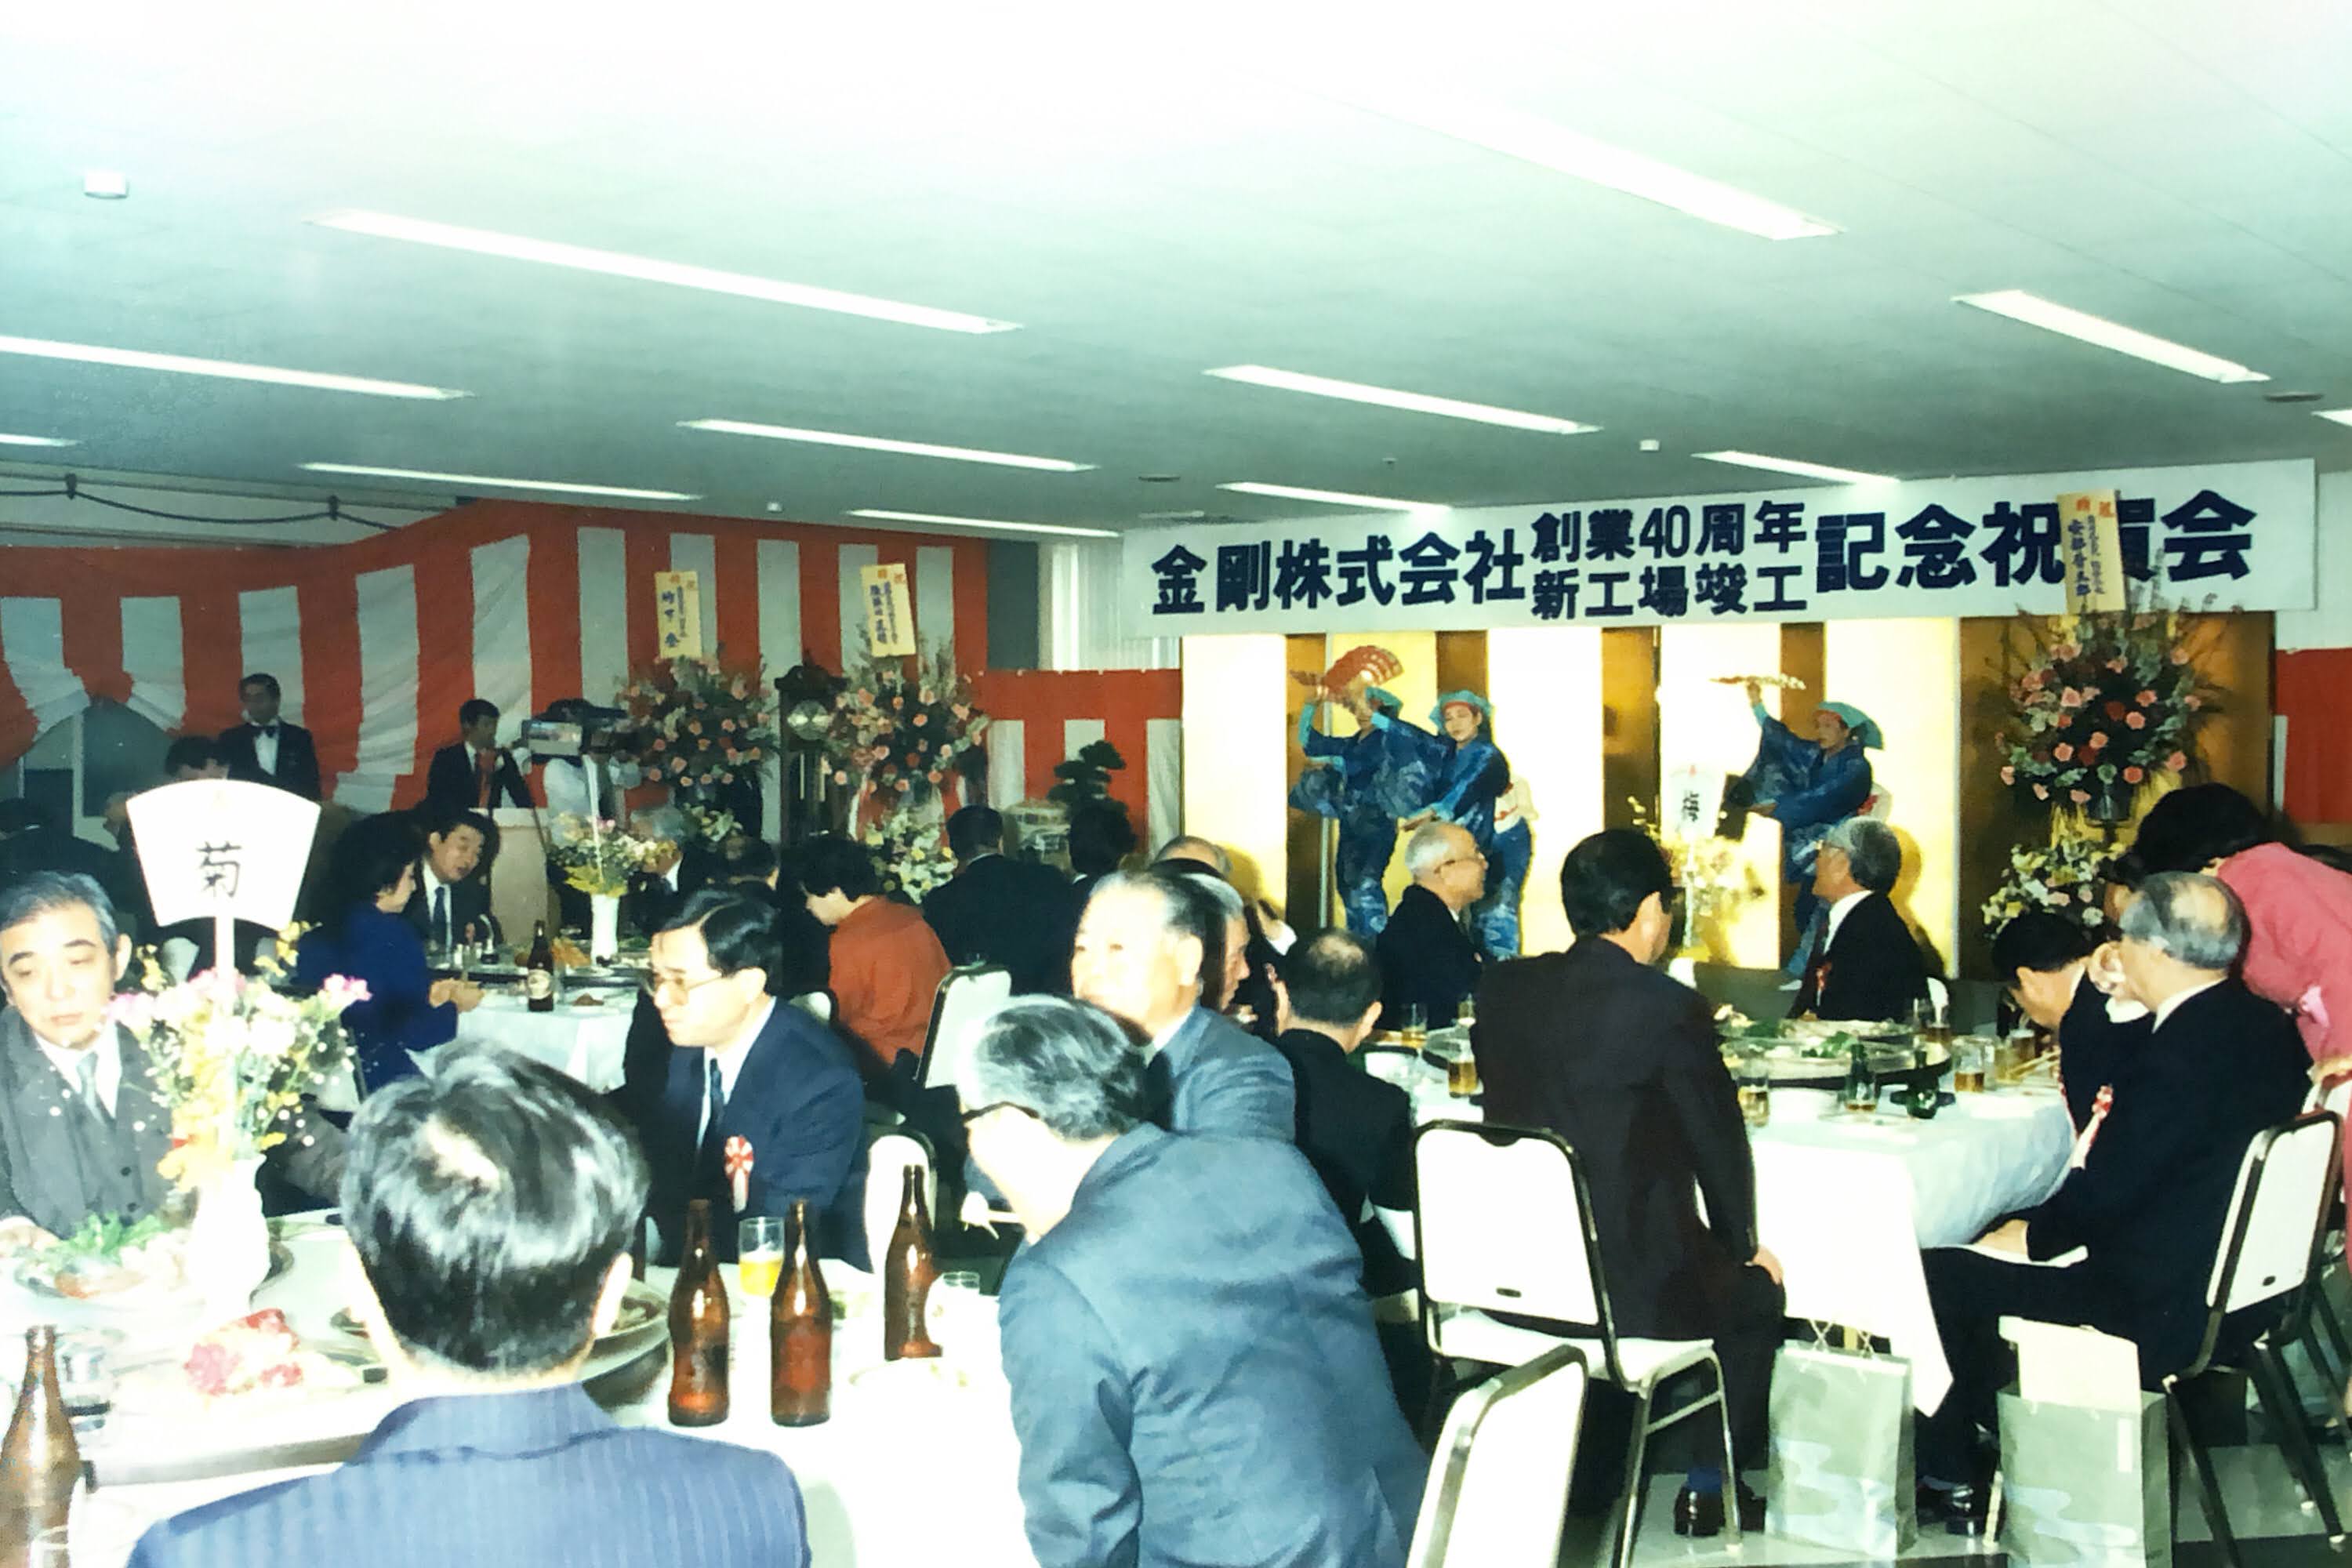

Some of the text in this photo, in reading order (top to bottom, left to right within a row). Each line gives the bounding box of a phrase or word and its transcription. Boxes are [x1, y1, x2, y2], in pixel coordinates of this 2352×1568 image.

[1530, 500, 1807, 562] 創業40周年
[1152, 529, 1525, 615] 金剛株式会社
[1530, 562, 1807, 619] 新工場竣工
[196, 842, 241, 898] 菊
